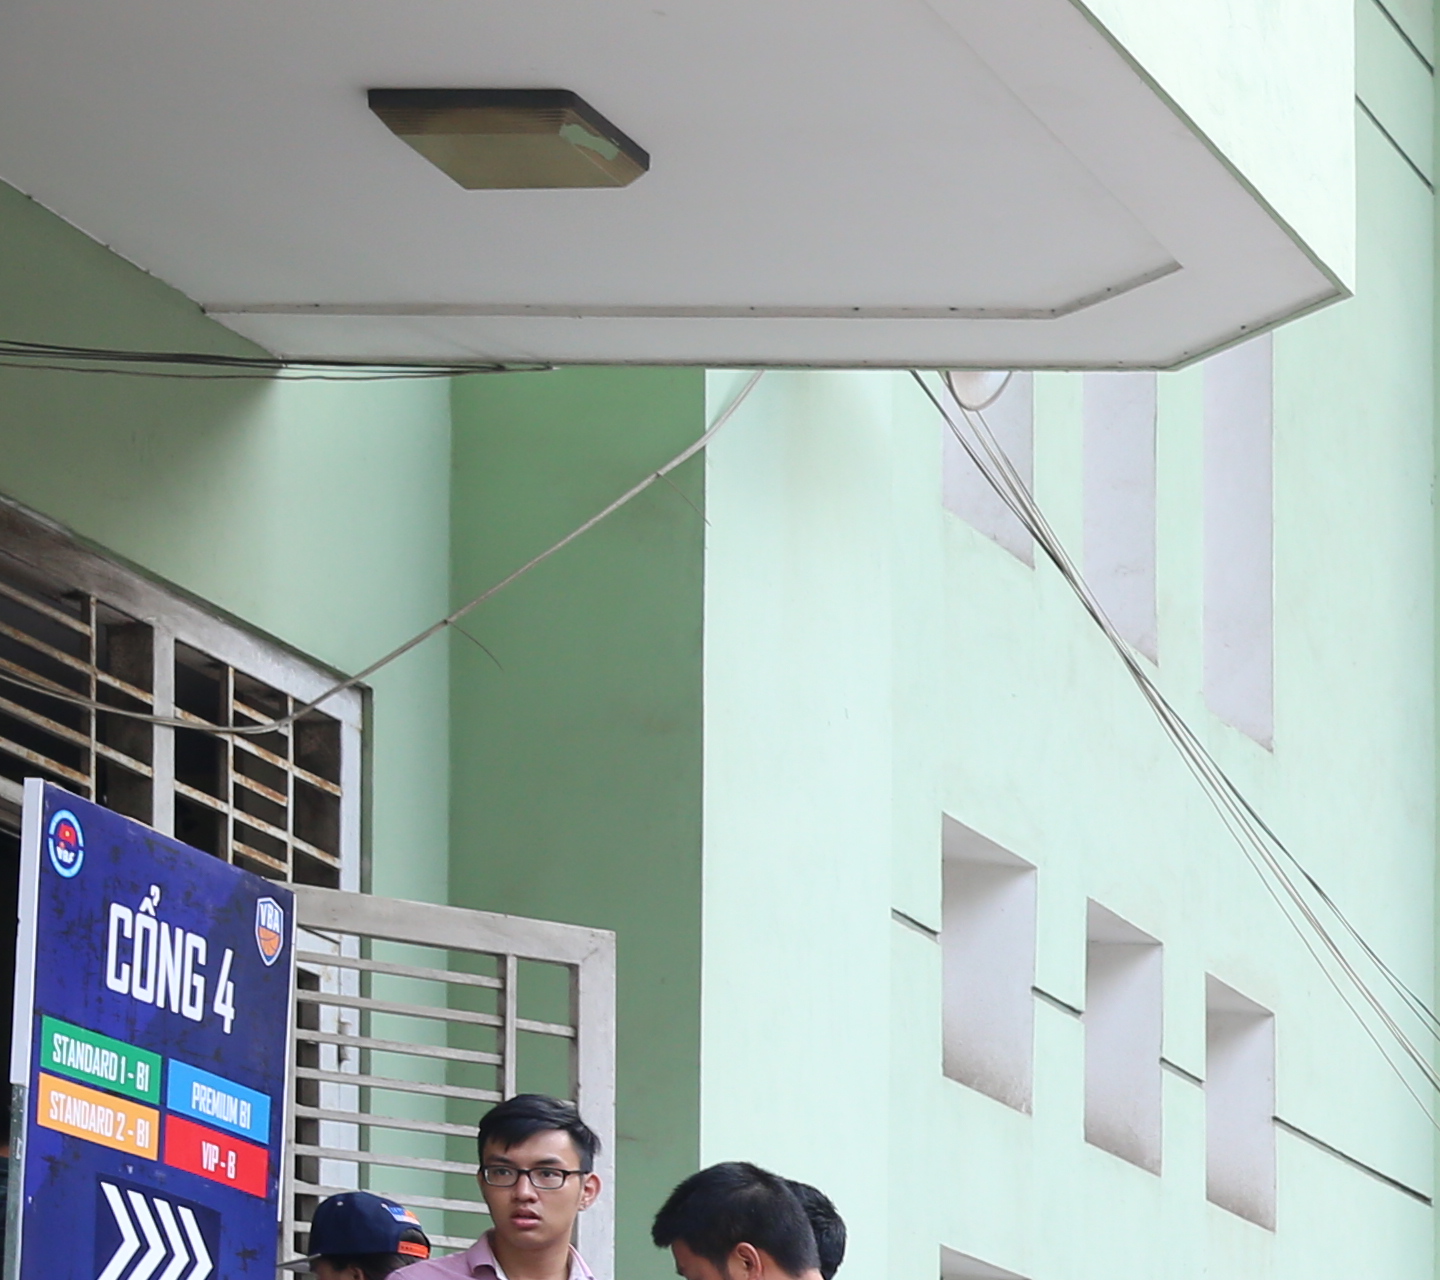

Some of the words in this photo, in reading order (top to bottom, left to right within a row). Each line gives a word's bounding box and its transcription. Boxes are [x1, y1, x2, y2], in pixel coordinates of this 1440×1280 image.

[106, 884, 207, 1022] CỔNG
[212, 948, 235, 1034] 4
[52, 1032, 117, 1081] STANDARD
[49, 1091, 114, 1138] STANDARD
[115, 1112, 126, 1141] 2
[191, 1081, 240, 1123] PREMIUM
[201, 1140, 219, 1172] VIP
[227, 1150, 236, 1179] B
